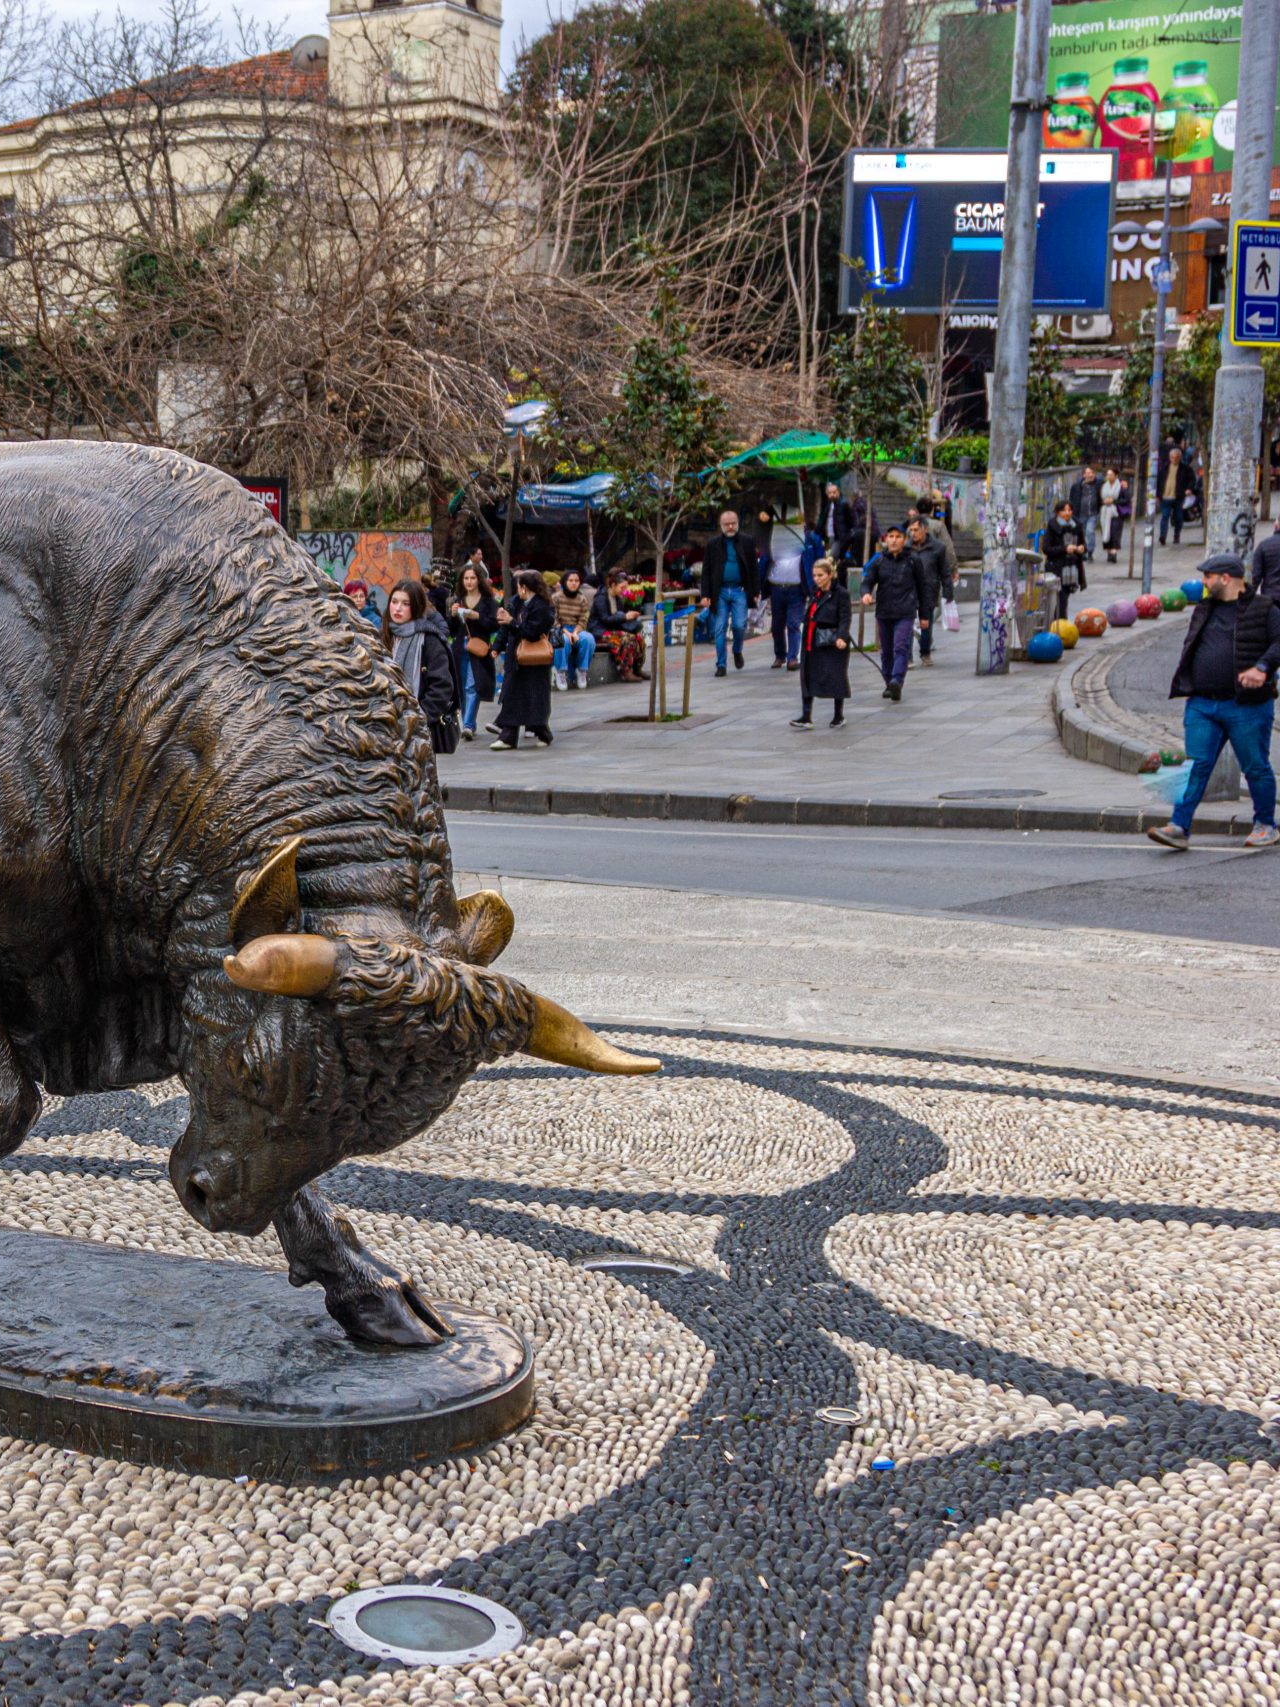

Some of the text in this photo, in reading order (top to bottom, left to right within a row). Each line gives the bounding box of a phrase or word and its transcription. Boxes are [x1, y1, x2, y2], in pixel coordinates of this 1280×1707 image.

[1048, 19, 1104, 38] hteşem
[1107, 13, 1159, 33] karışım
[1049, 40, 1117, 58] tanbul'un
[1121, 34, 1149, 50] tadı
